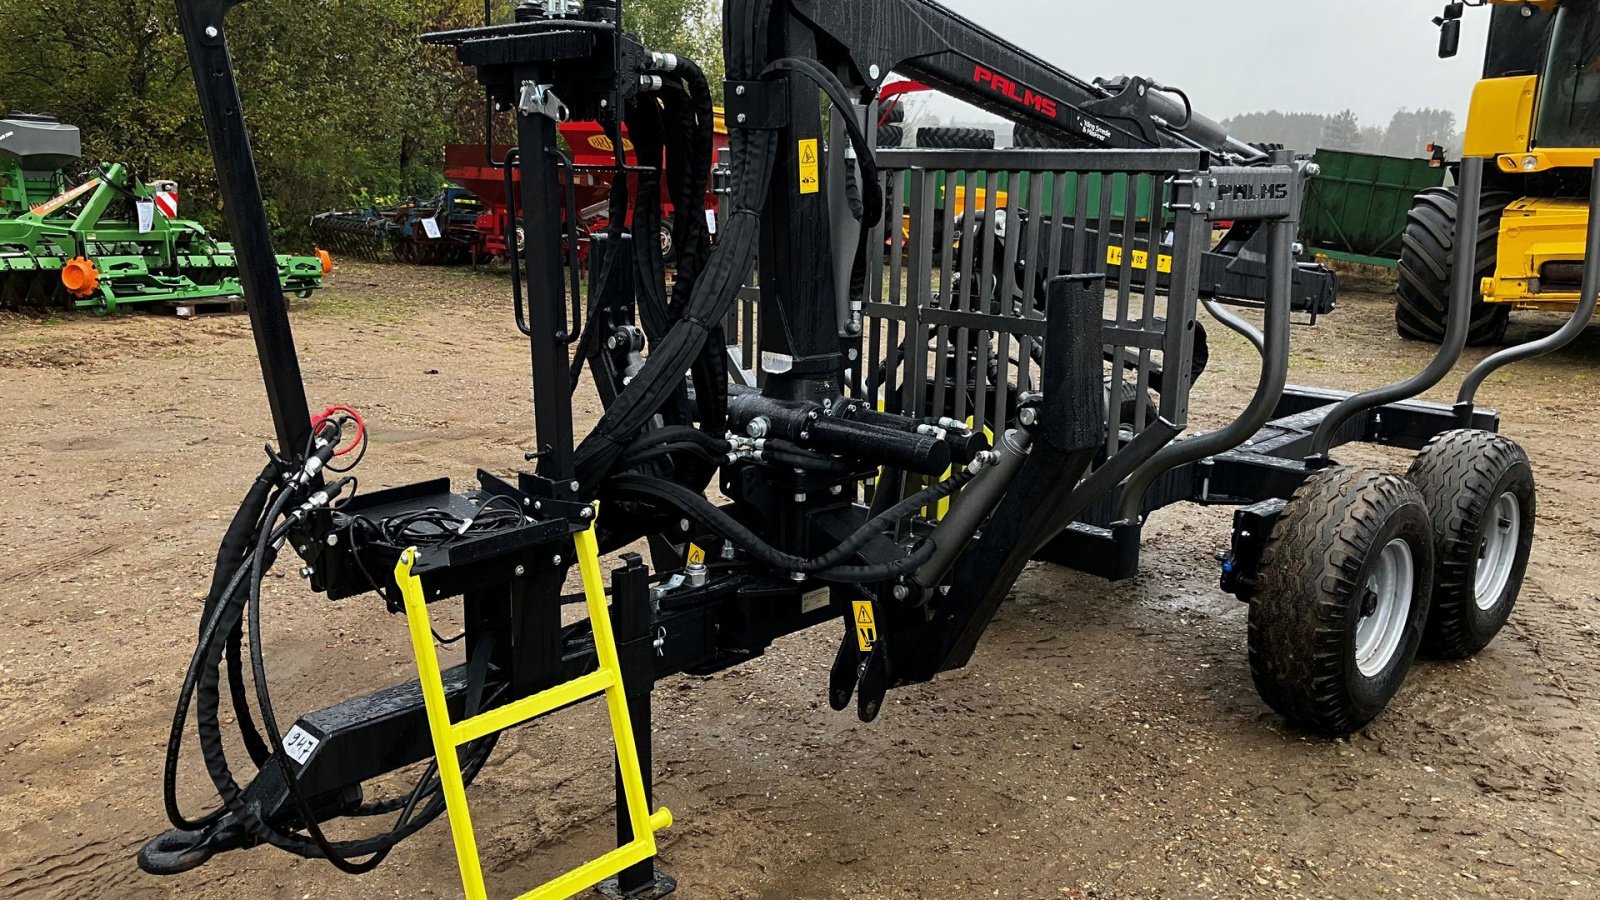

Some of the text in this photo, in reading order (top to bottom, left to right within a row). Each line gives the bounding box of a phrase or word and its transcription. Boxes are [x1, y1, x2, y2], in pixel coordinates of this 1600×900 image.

[973, 64, 1057, 118] PALMS
[1217, 183, 1288, 201] PALMS
[287, 732, 314, 760] 947
